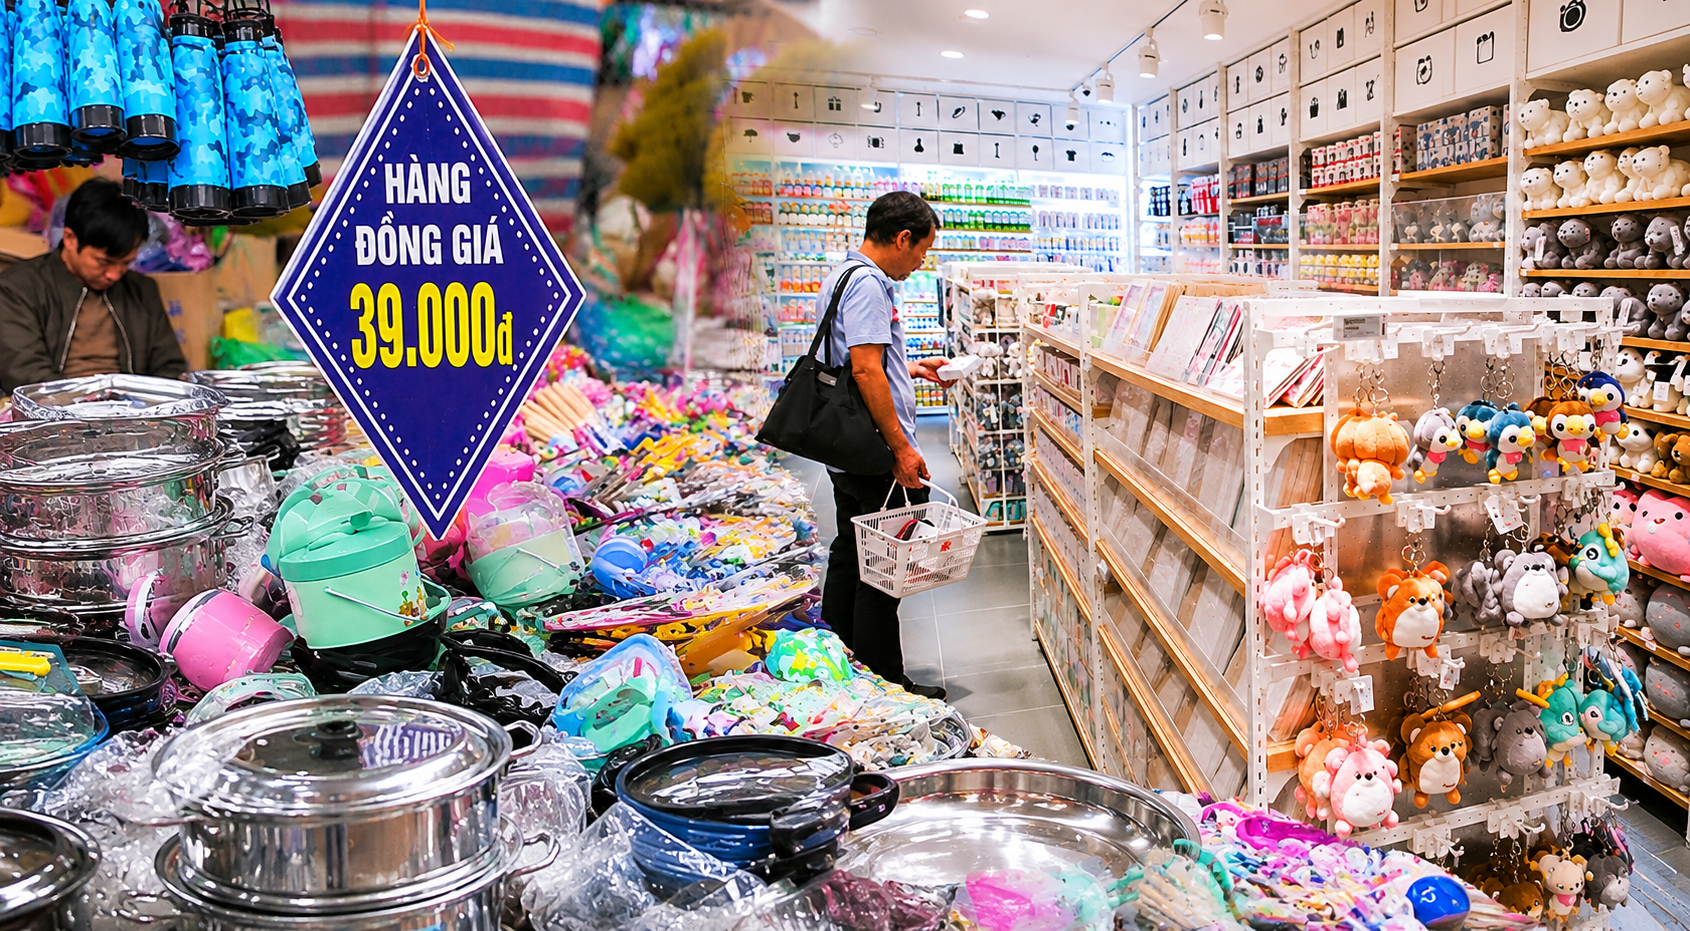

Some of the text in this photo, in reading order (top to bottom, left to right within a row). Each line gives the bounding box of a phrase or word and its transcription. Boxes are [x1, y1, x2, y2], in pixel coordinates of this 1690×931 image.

[384, 153, 472, 204] HÀNG
[354, 210, 504, 266] ĐỒNG GIÁ
[350, 281, 513, 369] 39.000đ
